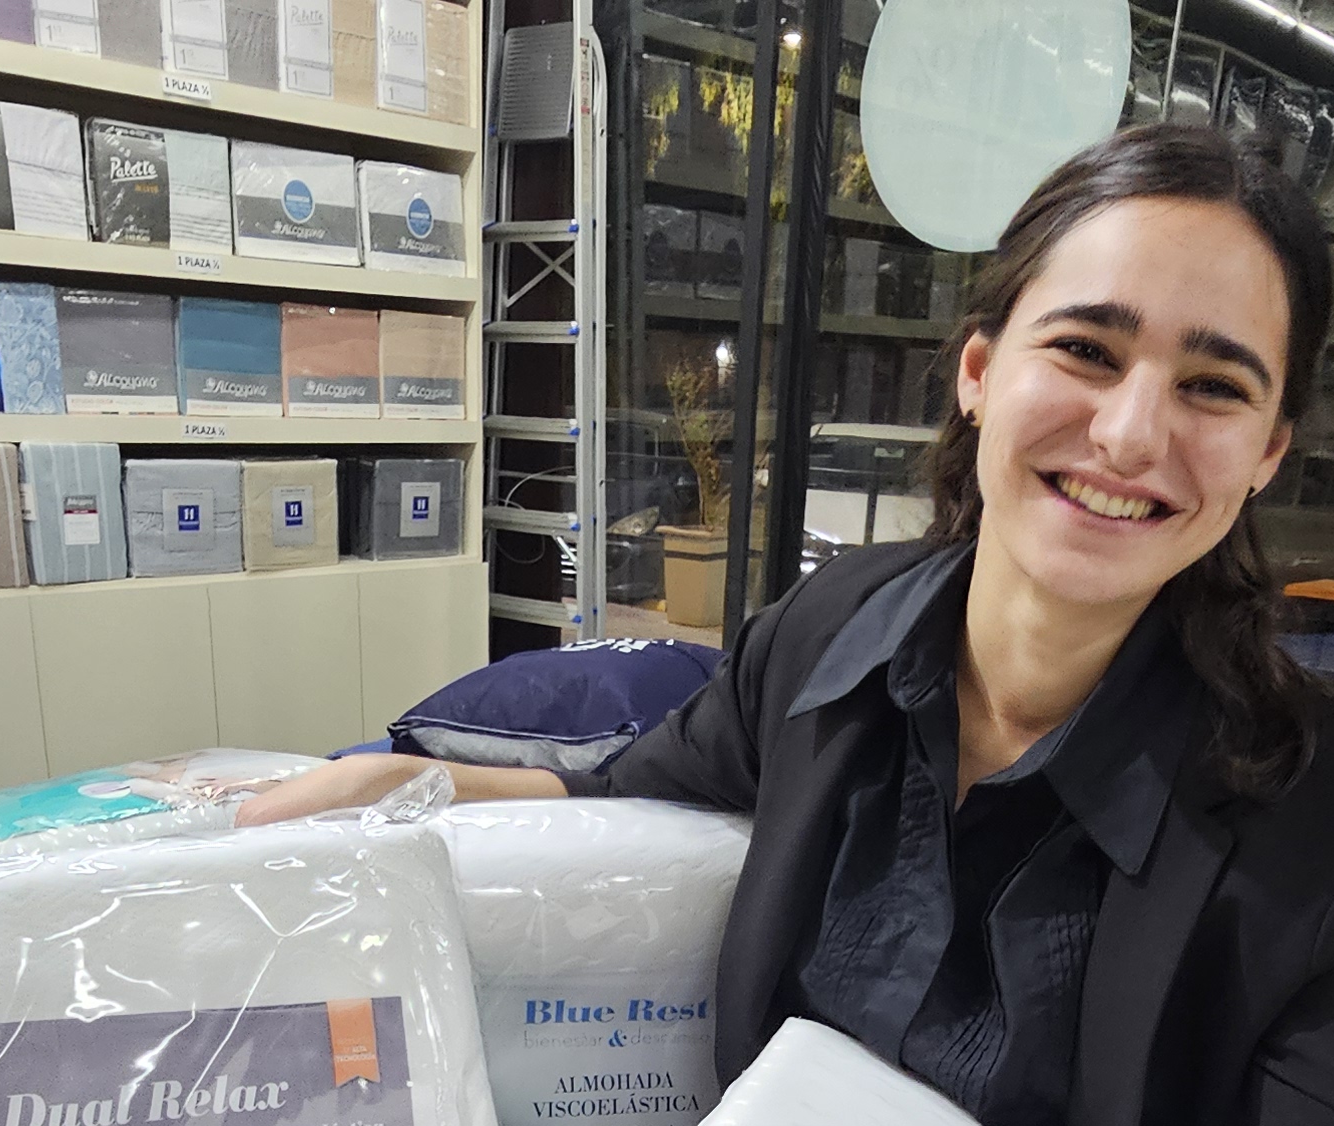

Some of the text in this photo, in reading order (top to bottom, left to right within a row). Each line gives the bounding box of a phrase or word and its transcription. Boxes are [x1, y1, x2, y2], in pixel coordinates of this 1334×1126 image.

[172, 79, 199, 93] PLAZA
[110, 157, 157, 179] Palette
[185, 256, 210, 268] PLAZA
[192, 425, 216, 436] PLAZA
[524, 998, 708, 1025] Blue Rest
[524, 1030, 605, 1049] bienestar
[608, 1029, 627, 1047] &
[554, 1071, 675, 1094] ALMOHADA
[146, 1074, 289, 1123] Relax
[533, 1092, 701, 1118] VISCOELÁSTICA
